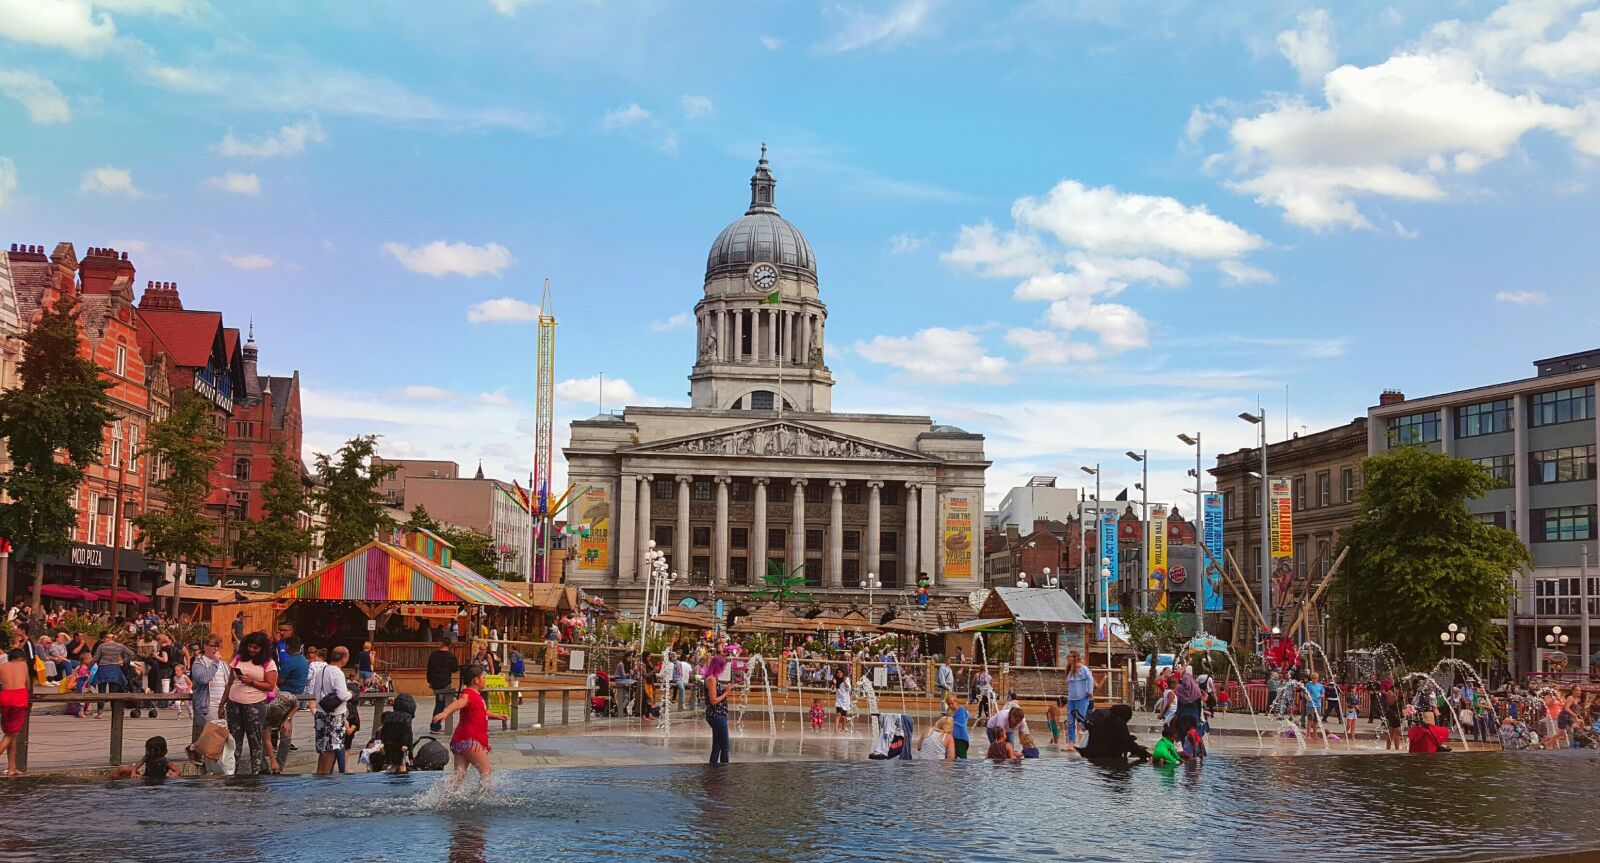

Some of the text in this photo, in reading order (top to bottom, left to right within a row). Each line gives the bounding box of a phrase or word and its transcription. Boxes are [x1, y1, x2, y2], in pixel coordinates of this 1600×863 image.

[1271, 498, 1279, 528] EXCLUSIVE
[1280, 498, 1291, 552] EXHIBITION
[72, 548, 102, 566] MOD PIZZA
